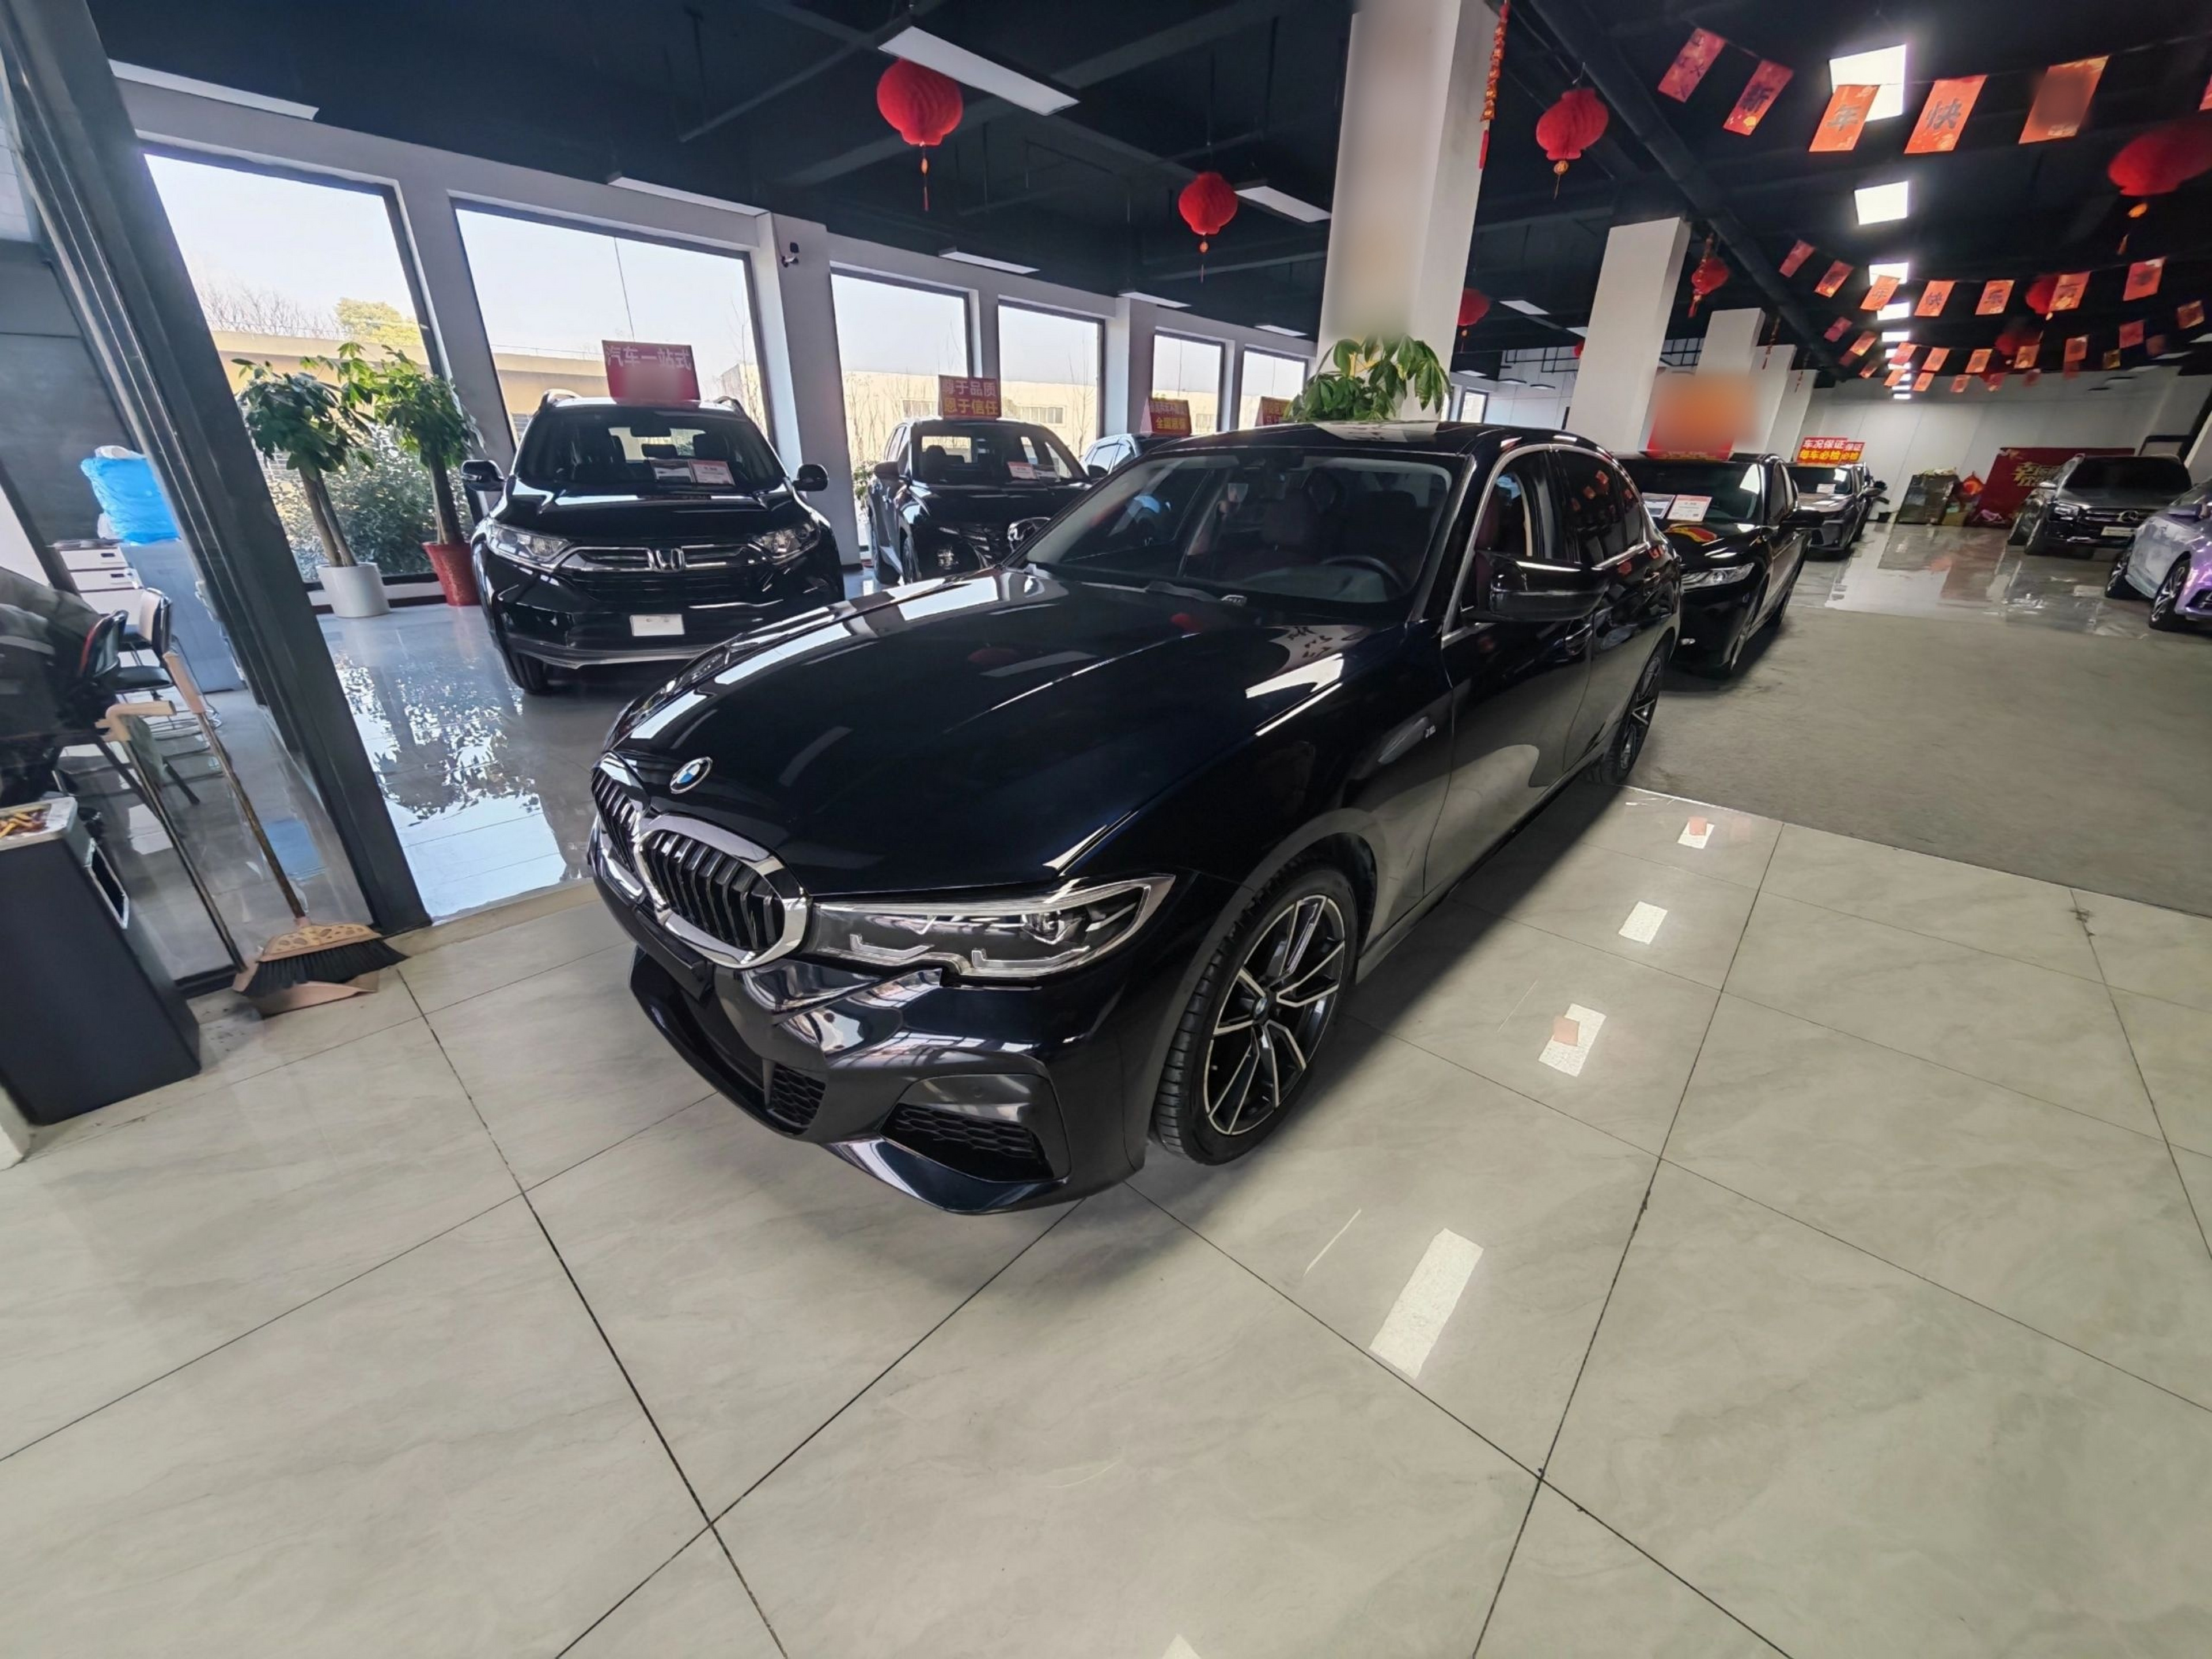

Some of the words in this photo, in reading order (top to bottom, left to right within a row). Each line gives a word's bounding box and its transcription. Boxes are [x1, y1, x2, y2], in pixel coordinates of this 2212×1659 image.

[1827, 104, 1862, 131] 年
[1926, 97, 1963, 130] 快
[606, 346, 691, 370] 汽车一站式
[1802, 440, 1845, 449] 车况保证
[1799, 449, 1841, 460] 每车必检
